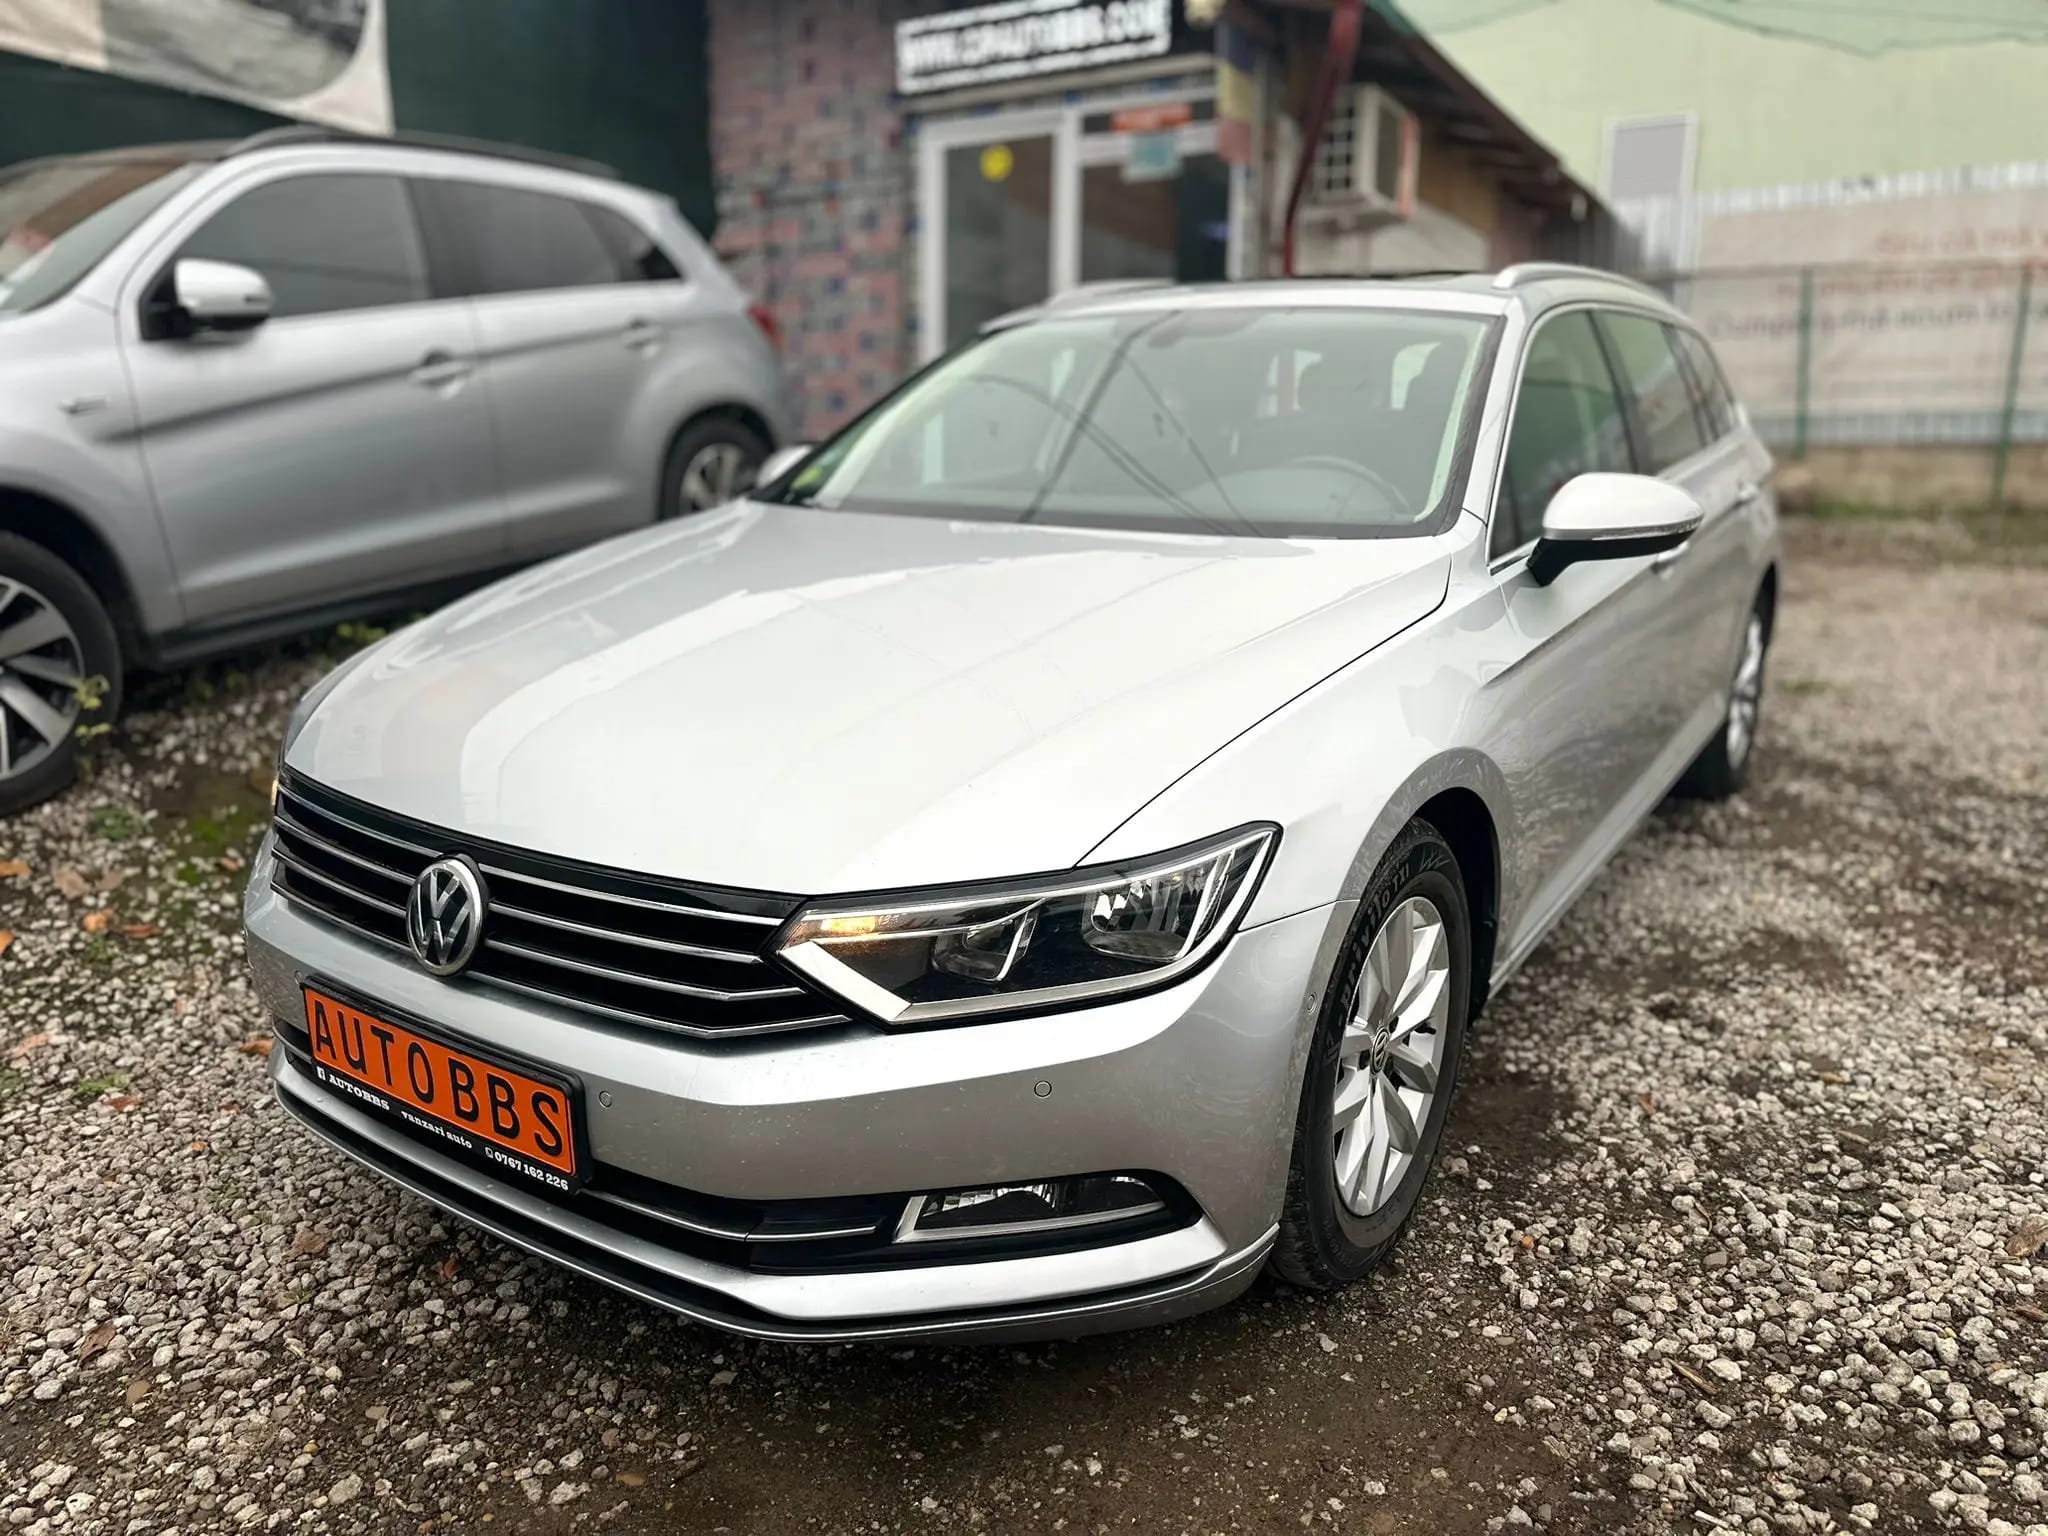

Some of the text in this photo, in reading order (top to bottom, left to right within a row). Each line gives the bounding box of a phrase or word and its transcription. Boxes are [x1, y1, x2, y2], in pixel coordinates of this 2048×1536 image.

[315, 1000, 563, 1156] AUTOBBS
[329, 1074, 569, 1191] AUTOBBS vanzari auto 0767 162 226
